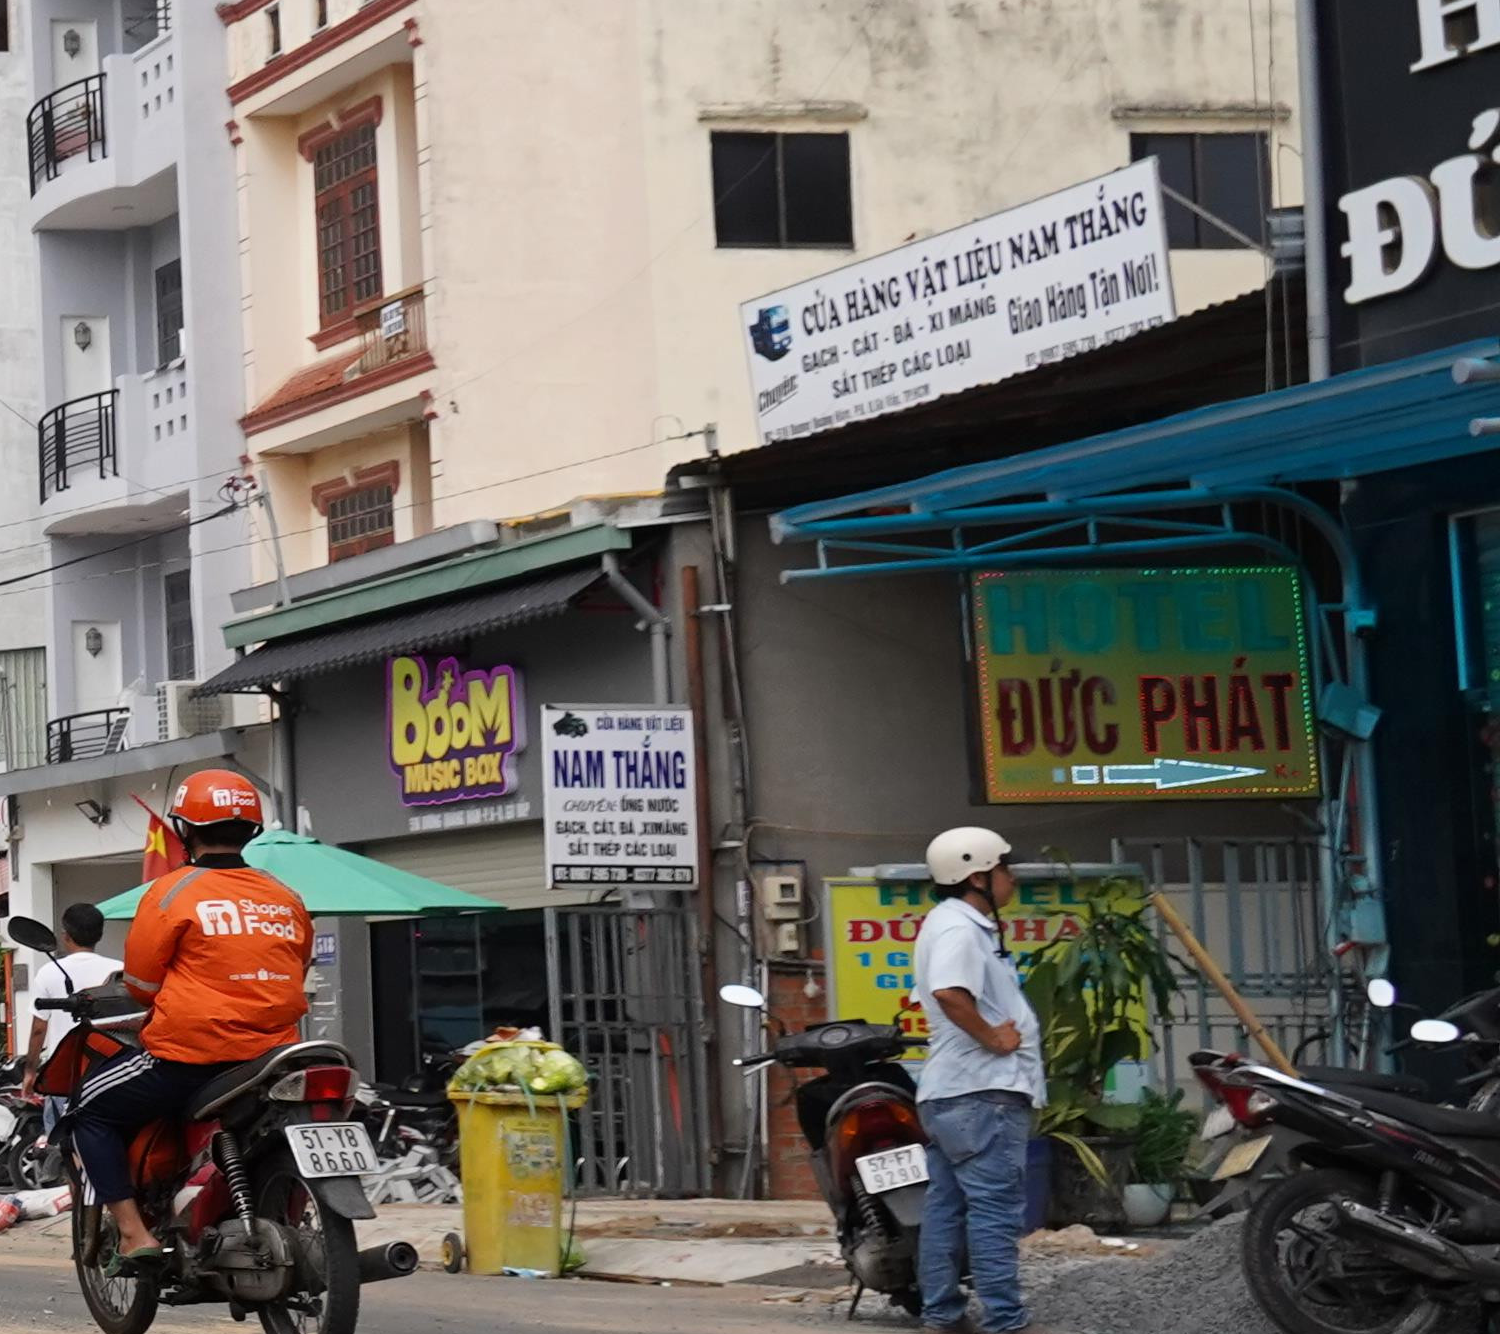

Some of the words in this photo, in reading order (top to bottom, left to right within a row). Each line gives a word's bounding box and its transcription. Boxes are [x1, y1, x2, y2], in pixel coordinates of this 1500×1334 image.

[802, 289, 842, 336] CỬA
[845, 278, 901, 323] HÀNG
[905, 256, 948, 307] VẬT
[954, 237, 1002, 289] LIỆU
[1008, 221, 1060, 269] NAM
[1064, 184, 1147, 250] THẮNG
[1007, 295, 1044, 336] Giao
[1045, 281, 1088, 324] Hàng
[902, 347, 934, 378] CÁC
[936, 338, 973, 367] LOẠI
[986, 579, 1292, 656] HOTEL
[996, 657, 1120, 758] ĐỨC
[1138, 655, 1297, 755] PHÁT
[404, 758, 462, 794] MUSIC
[464, 752, 503, 787] BOX
[553, 750, 606, 789] NAM
[612, 735, 687, 790] THẮNG
[238, 898, 293, 917] Shopee
[877, 881, 1088, 907] HEL
[244, 915, 297, 940] Food
[299, 1128, 359, 1150] 51-Y8
[309, 1151, 368, 1173] 8660
